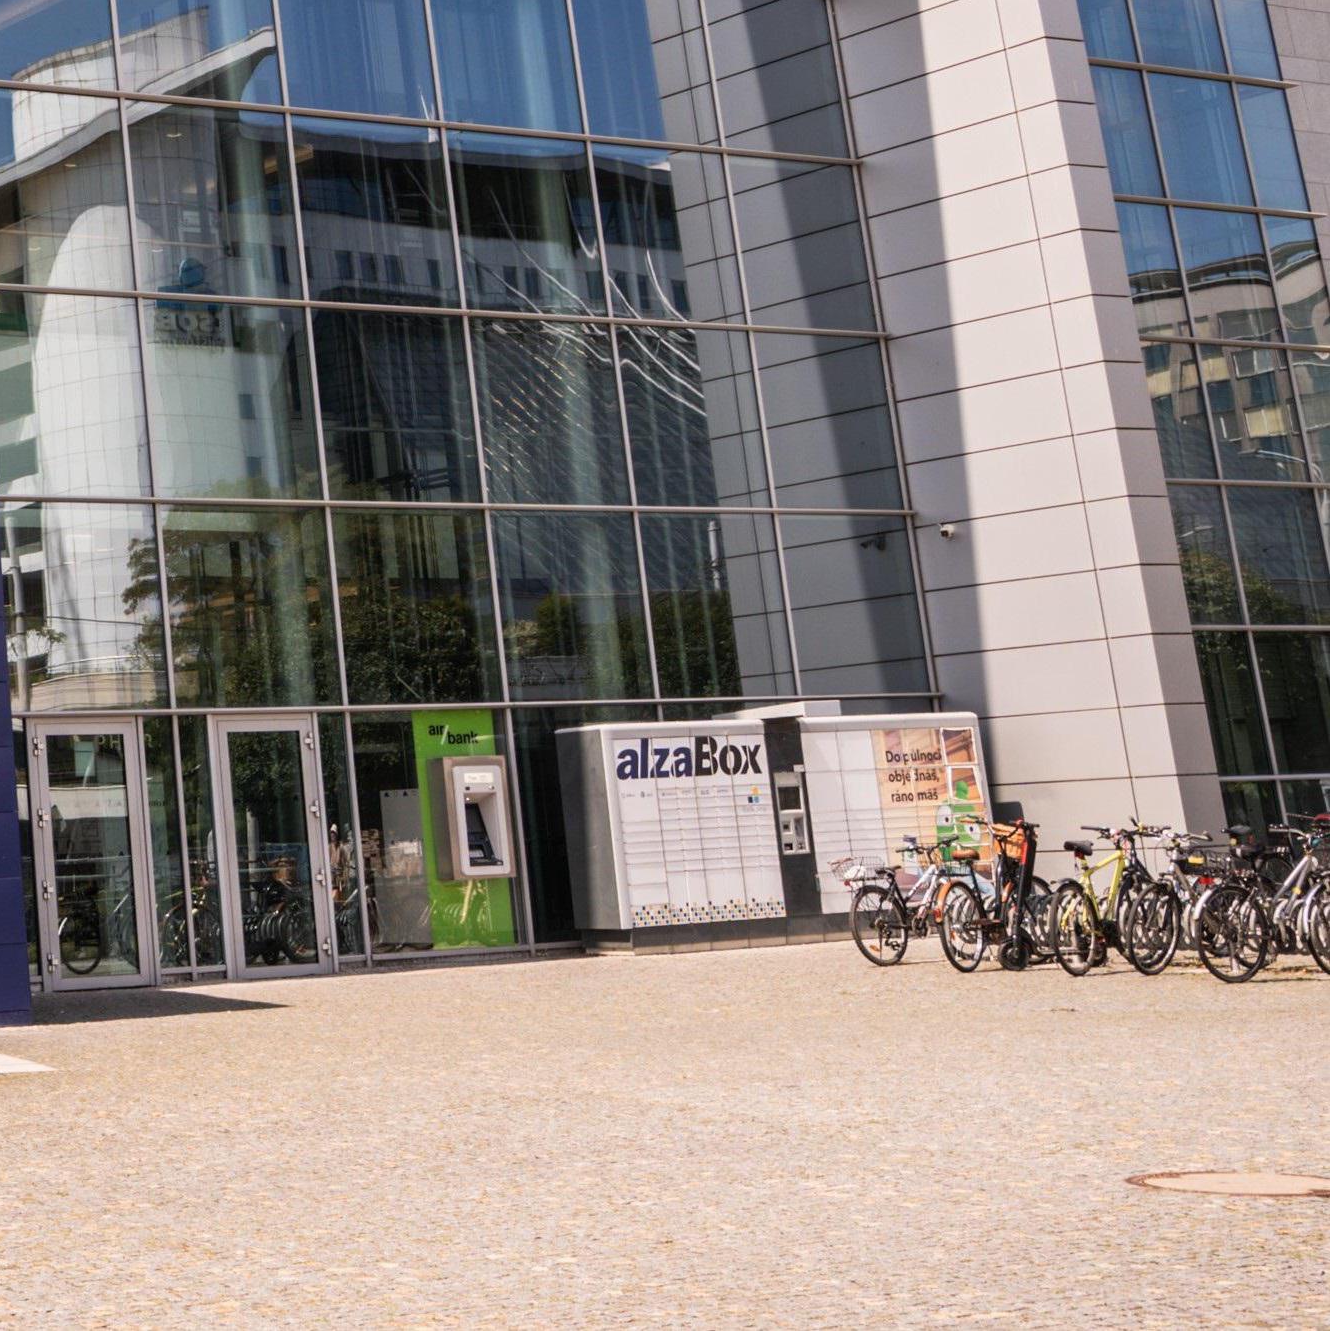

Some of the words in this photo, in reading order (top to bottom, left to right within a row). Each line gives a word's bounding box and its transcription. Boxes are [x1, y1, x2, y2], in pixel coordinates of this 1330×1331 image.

[448, 731, 479, 745] bank
[616, 735, 763, 781] alzaBox
[885, 751, 901, 763] Do
[891, 789, 914, 803] ráno
[917, 787, 939, 801] máš
